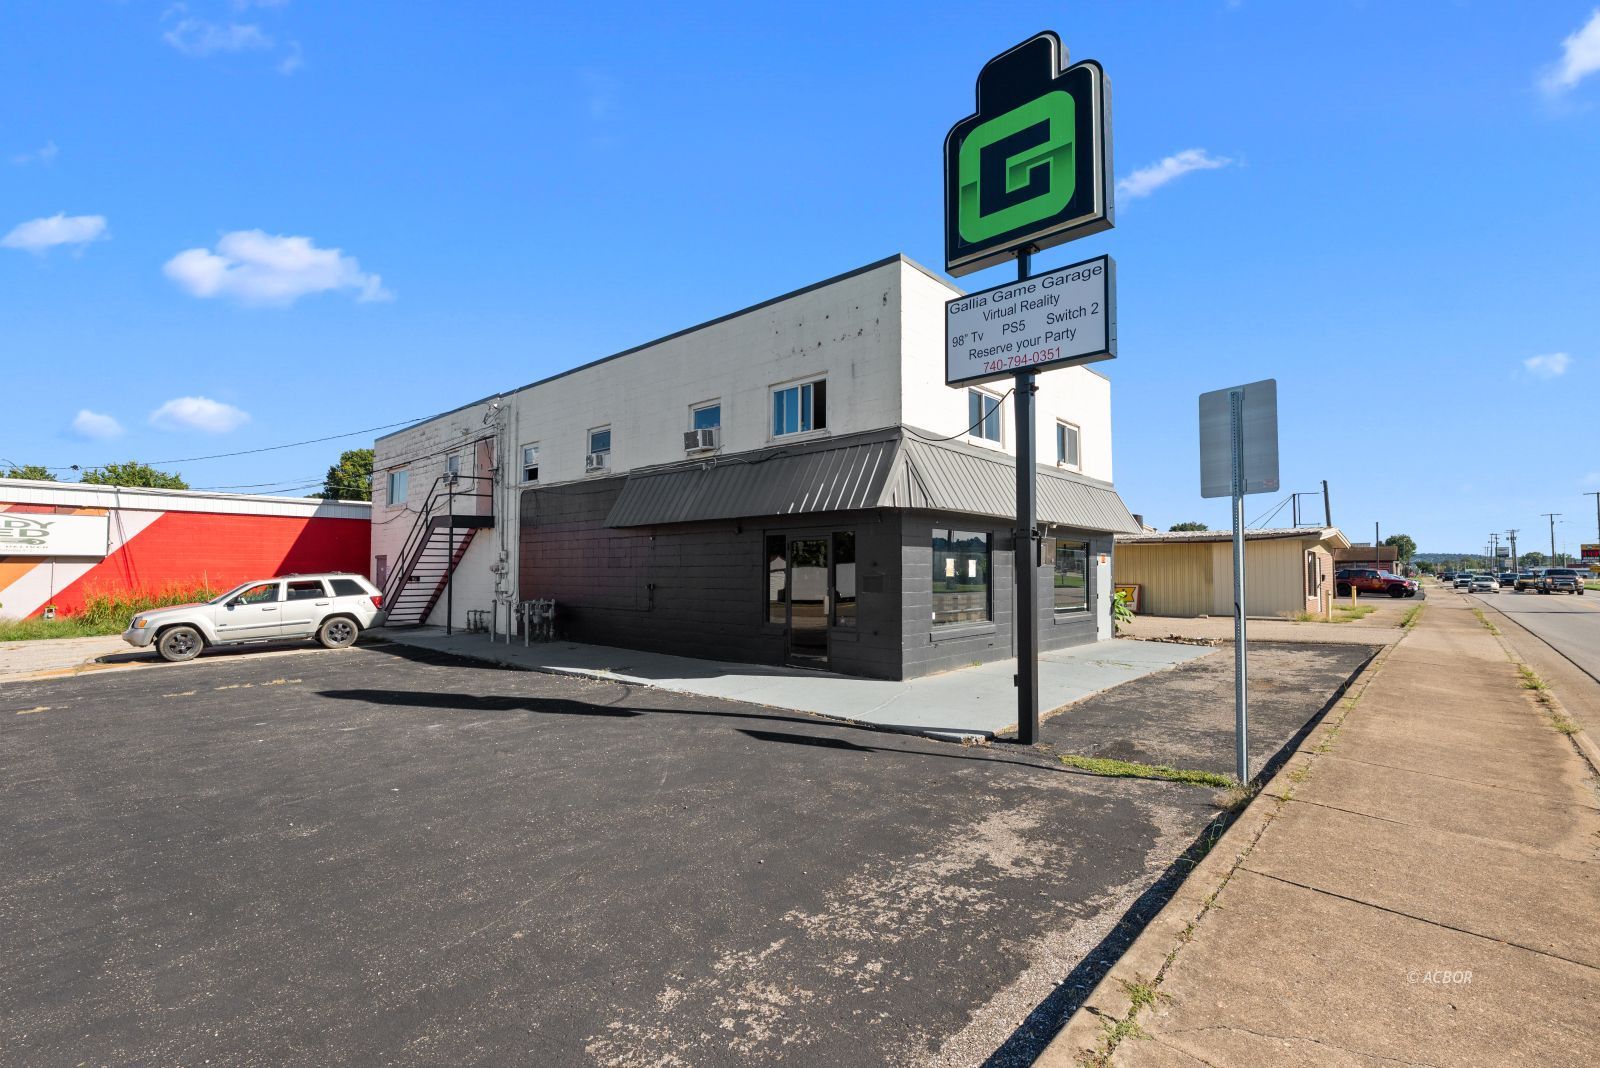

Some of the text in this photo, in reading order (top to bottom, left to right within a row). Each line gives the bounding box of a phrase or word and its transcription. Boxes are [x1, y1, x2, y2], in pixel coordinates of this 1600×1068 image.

[949, 265, 1103, 315] Gallia Game Garage
[983, 294, 1060, 322] Virtual Reality
[952, 302, 1099, 348] 98" Tv PS5 Switch 2
[969, 327, 1077, 360] Reserve your Party
[984, 347, 1061, 373] 740-794-0351
